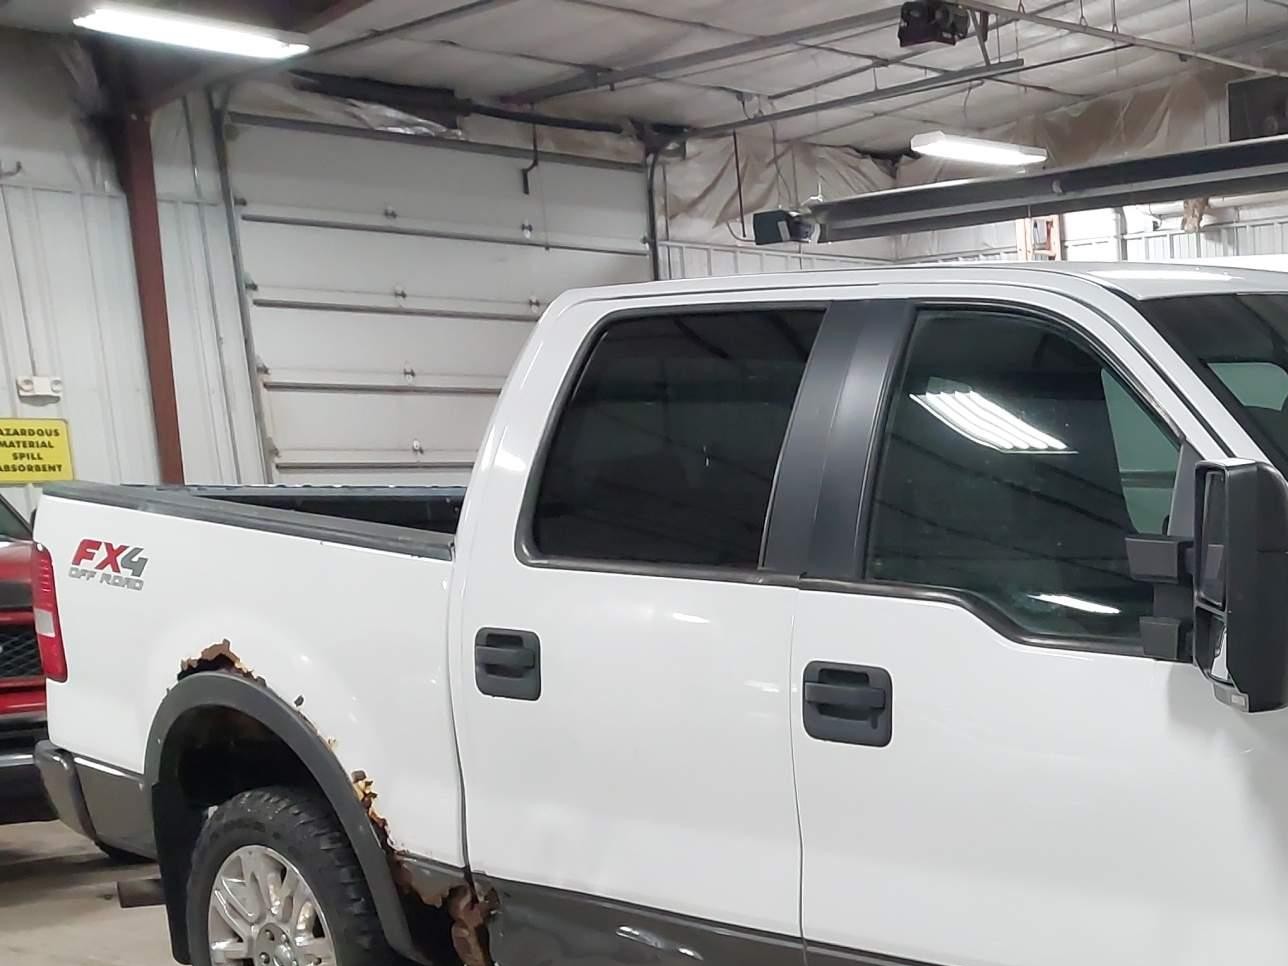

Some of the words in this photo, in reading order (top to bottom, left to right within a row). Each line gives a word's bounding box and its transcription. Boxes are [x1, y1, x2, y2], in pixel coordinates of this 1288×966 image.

[0, 427, 60, 437] AZARDOUS
[0, 440, 54, 449] MATERIAL
[12, 452, 44, 461] SPILL
[71, 538, 149, 577] FX4
[68, 567, 97, 581] OFF
[100, 573, 145, 591] ROAD
